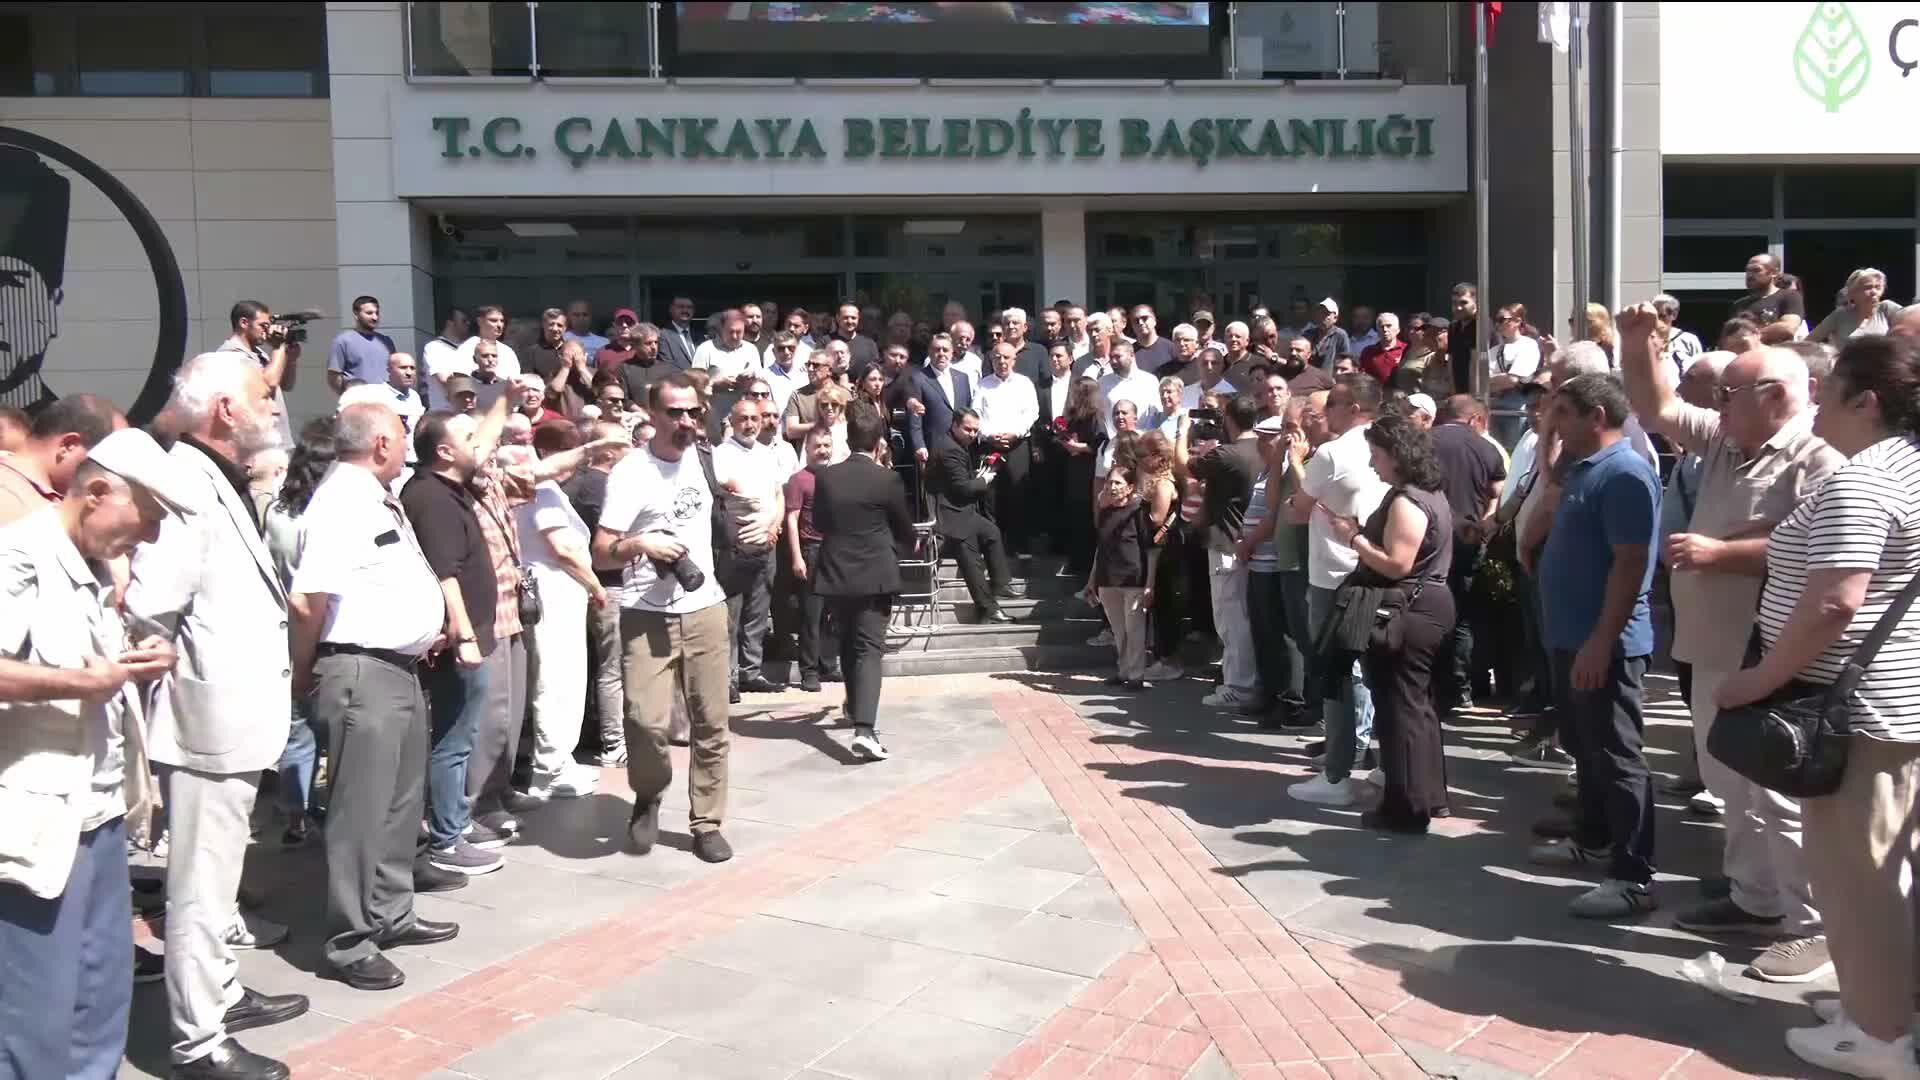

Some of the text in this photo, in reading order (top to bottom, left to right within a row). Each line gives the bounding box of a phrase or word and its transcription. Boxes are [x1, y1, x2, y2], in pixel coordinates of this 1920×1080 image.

[432, 108, 1434, 168] T.C. ÇANKAYA BELEDİYE BAŞKANLIĞI
